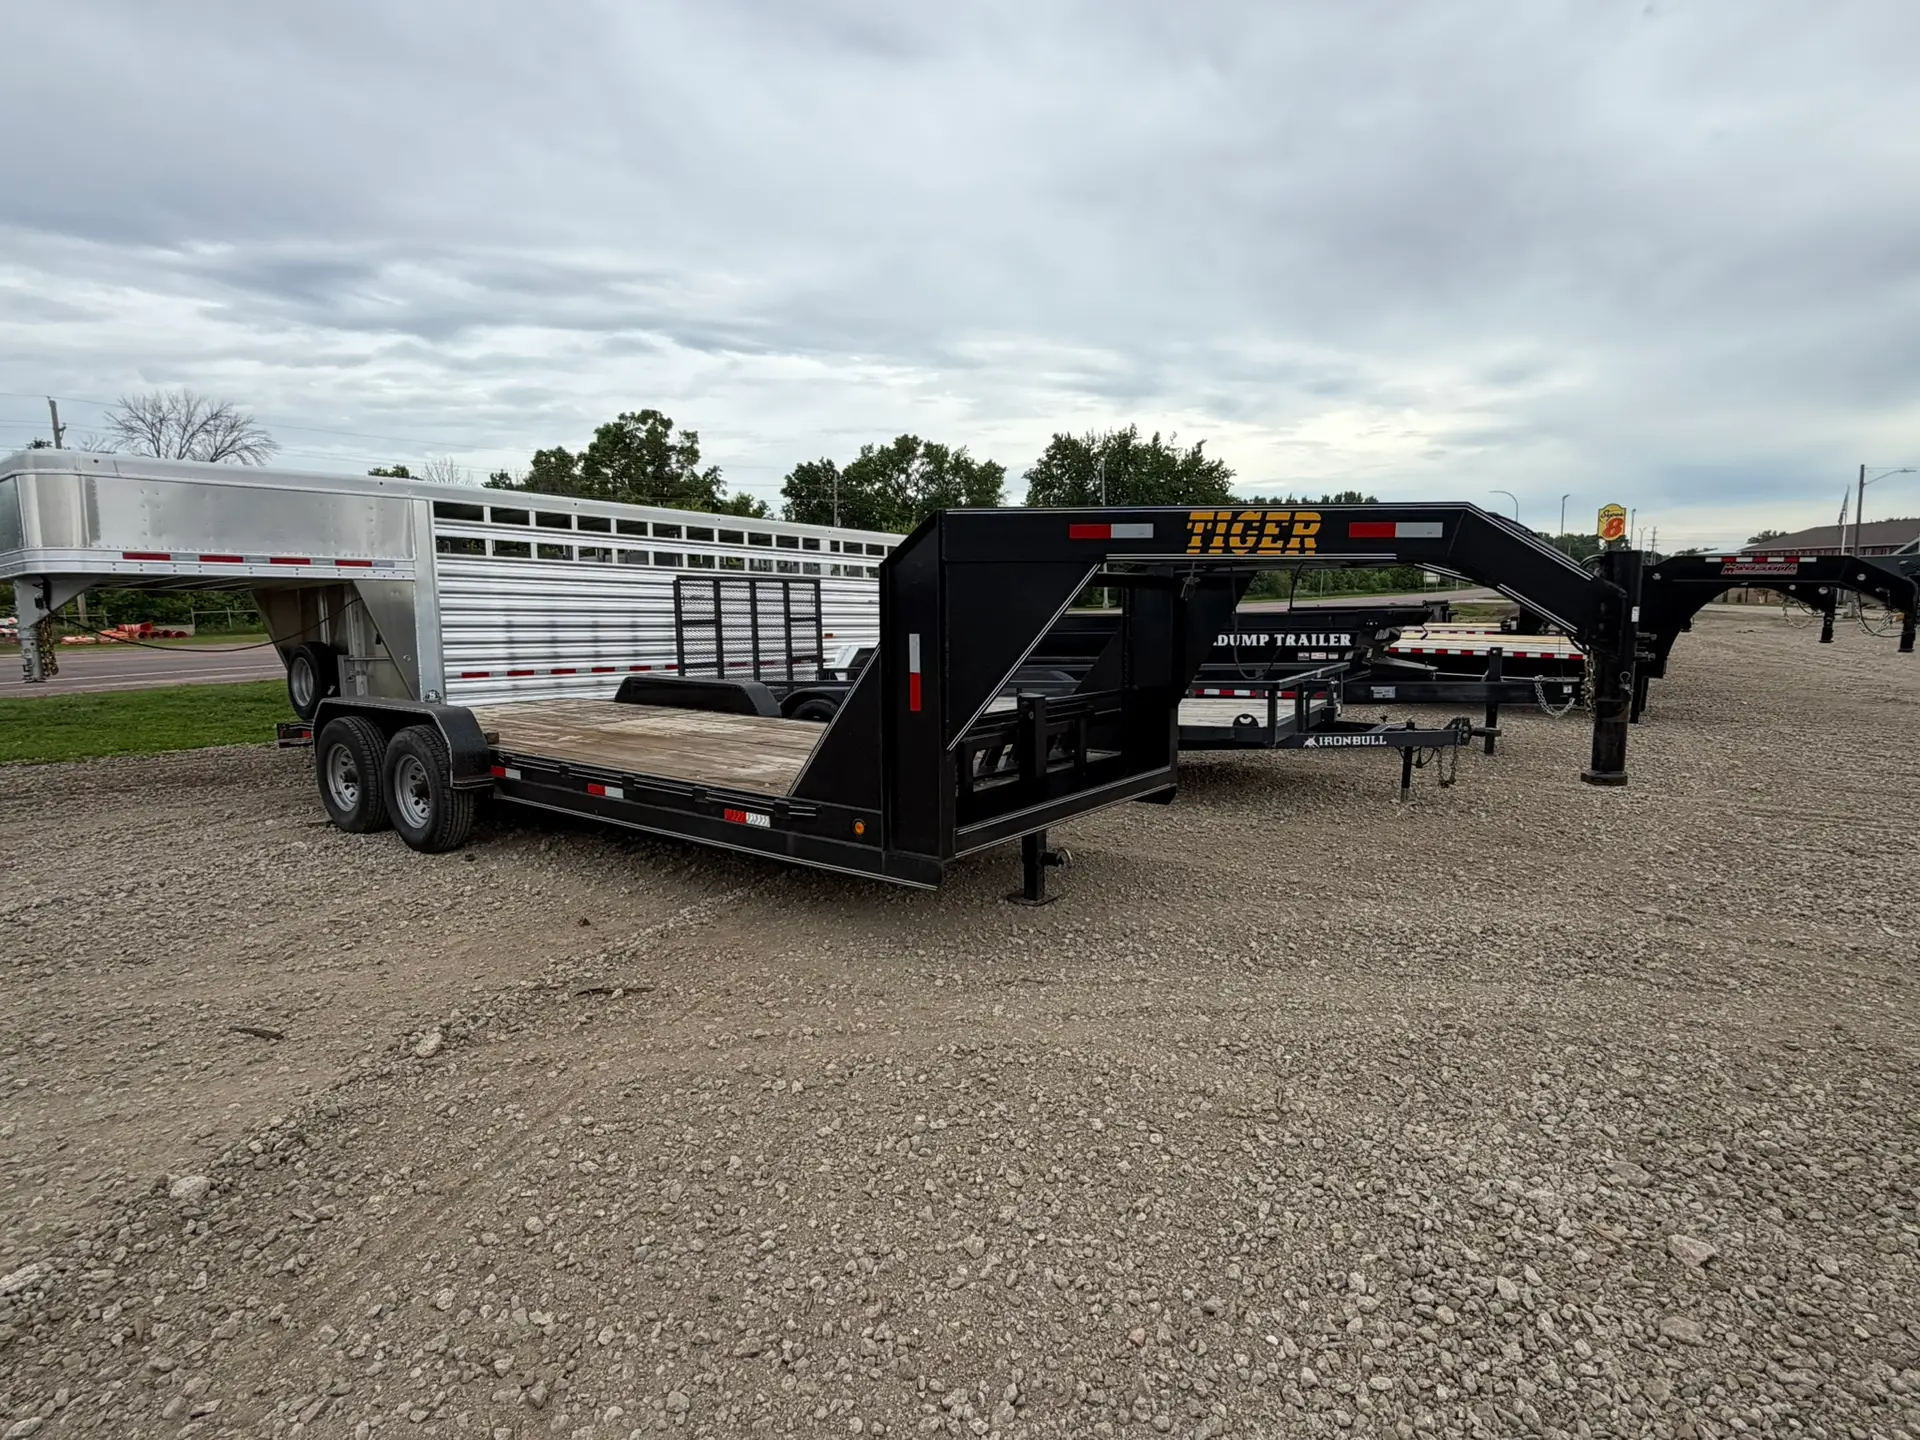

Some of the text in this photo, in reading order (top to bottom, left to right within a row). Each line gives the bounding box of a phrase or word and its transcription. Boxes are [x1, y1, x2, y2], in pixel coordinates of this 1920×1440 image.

[1186, 511, 1322, 555] TIGER
[1602, 517, 1624, 538] 8
[1217, 634, 1352, 646] DUMP TRAILER
[1318, 735, 1388, 746] IRONBULL
